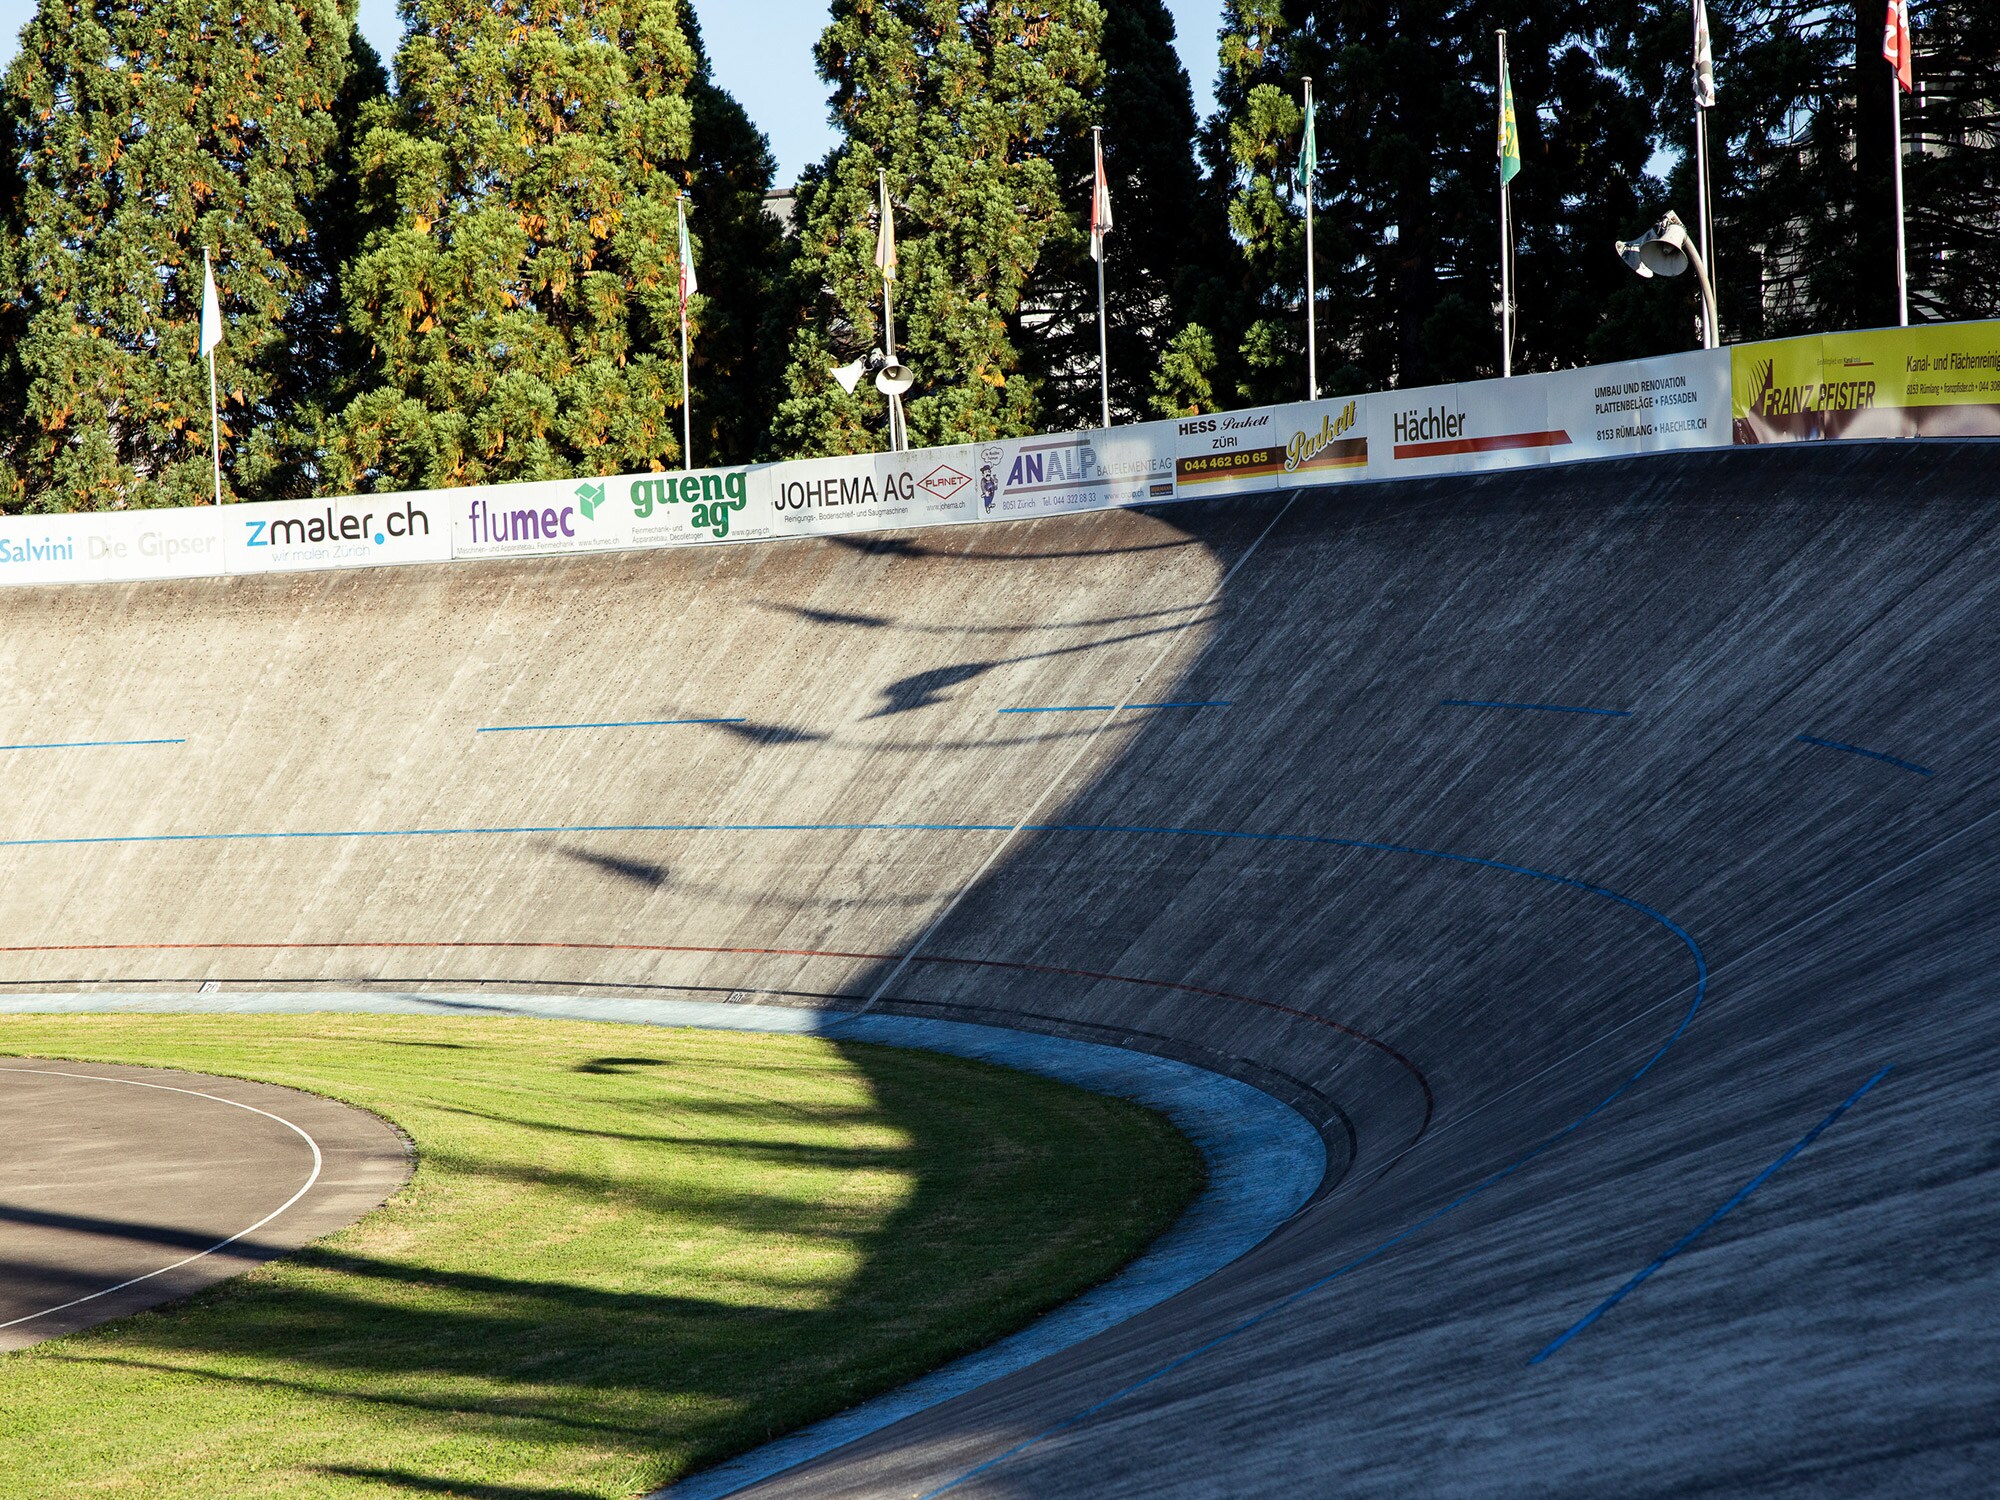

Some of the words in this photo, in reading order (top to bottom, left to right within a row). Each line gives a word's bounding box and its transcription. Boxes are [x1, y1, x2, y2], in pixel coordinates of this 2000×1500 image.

[1906, 355, 1930, 372] Kanal-
[1933, 353, 1948, 370] und
[1594, 384, 1622, 398] UMBAU
[1624, 382, 1639, 394] UND
[1641, 376, 1686, 392] RENOVATION
[1979, 381, 1988, 392] 044
[1596, 396, 1653, 414] PLATTENBELÄGE
[1660, 392, 1697, 406] FASSADEN
[1763, 384, 1815, 416] FRANZ
[1817, 380, 1876, 411] PFISTER
[1179, 419, 1217, 436] HESS
[1220, 415, 1270, 431] Parkett
[1394, 406, 1465, 442] Hächler
[1596, 430, 1614, 441] 8153
[1616, 424, 1652, 439] RÜMLANG
[1660, 418, 1707, 433] HAECHLER.CH
[1212, 436, 1238, 449] ZÜRI
[1284, 400, 1357, 472] Parkett
[1006, 447, 1097, 486] ANALP
[1097, 459, 1157, 477] BAUELEMENTE
[1159, 457, 1172, 469] AG
[1184, 459, 1207, 471] 044
[1210, 457, 1232, 468] 462
[1234, 454, 1250, 465] 60
[1252, 452, 1268, 463] 65
[774, 476, 877, 510] JOHEMA
[883, 472, 915, 502] AG
[925, 476, 964, 488] PLANET
[630, 472, 747, 518] gueng
[1017, 498, 1036, 509] Zürich
[1042, 497, 1052, 507] Tel.
[1053, 496, 1065, 505] 044
[1067, 495, 1079, 504] 322
[1088, 493, 1097, 502] 33
[856, 510, 867, 518] und
[868, 507, 908, 518] Saugmaschinen
[926, 501, 966, 512] www.johema.ch
[245, 501, 429, 546] zmaler.ch
[469, 501, 575, 543] flumec
[691, 502, 736, 538] ag
[731, 527, 769, 537] www.gueng.ch
[0, 536, 73, 563] Salvini
[88, 535, 127, 560] Die
[138, 532, 216, 562] Gipser
[272, 552, 288, 562] wir
[293, 548, 329, 561] malen
[333, 545, 370, 558] Zürich
